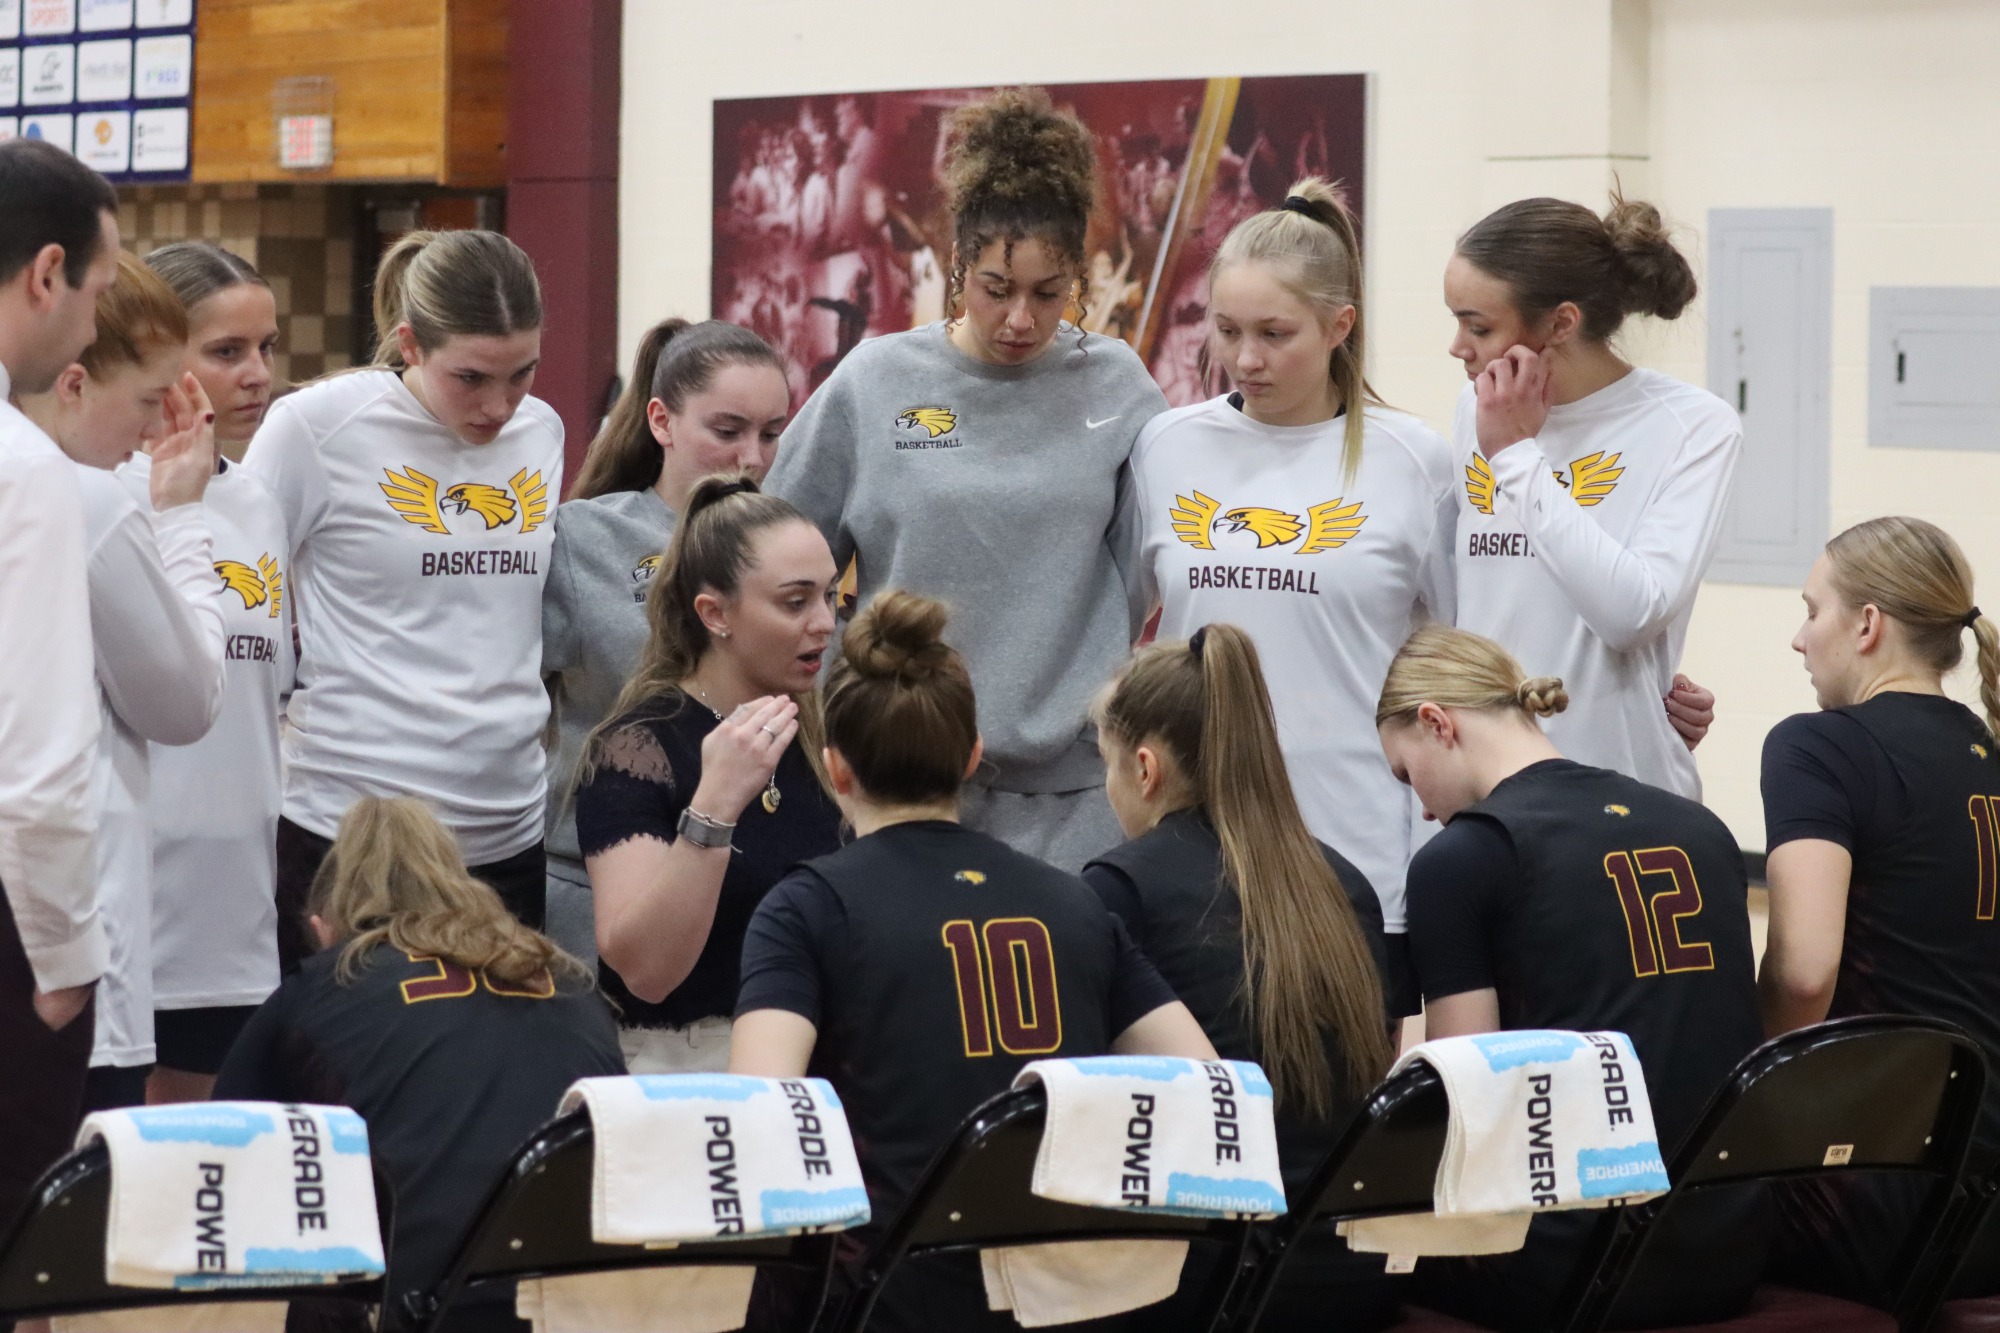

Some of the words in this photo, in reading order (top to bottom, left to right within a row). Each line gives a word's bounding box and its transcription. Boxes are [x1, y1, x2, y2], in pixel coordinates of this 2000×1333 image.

[895, 439, 963, 450] BASKETBALL
[1469, 532, 1536, 557] BASKET
[421, 550, 538, 577] BASKETBALL
[1189, 565, 1320, 595] BASKETBALL
[1968, 794, 2000, 920] 1
[1603, 845, 1715, 978] 12
[942, 917, 1062, 1057] 10
